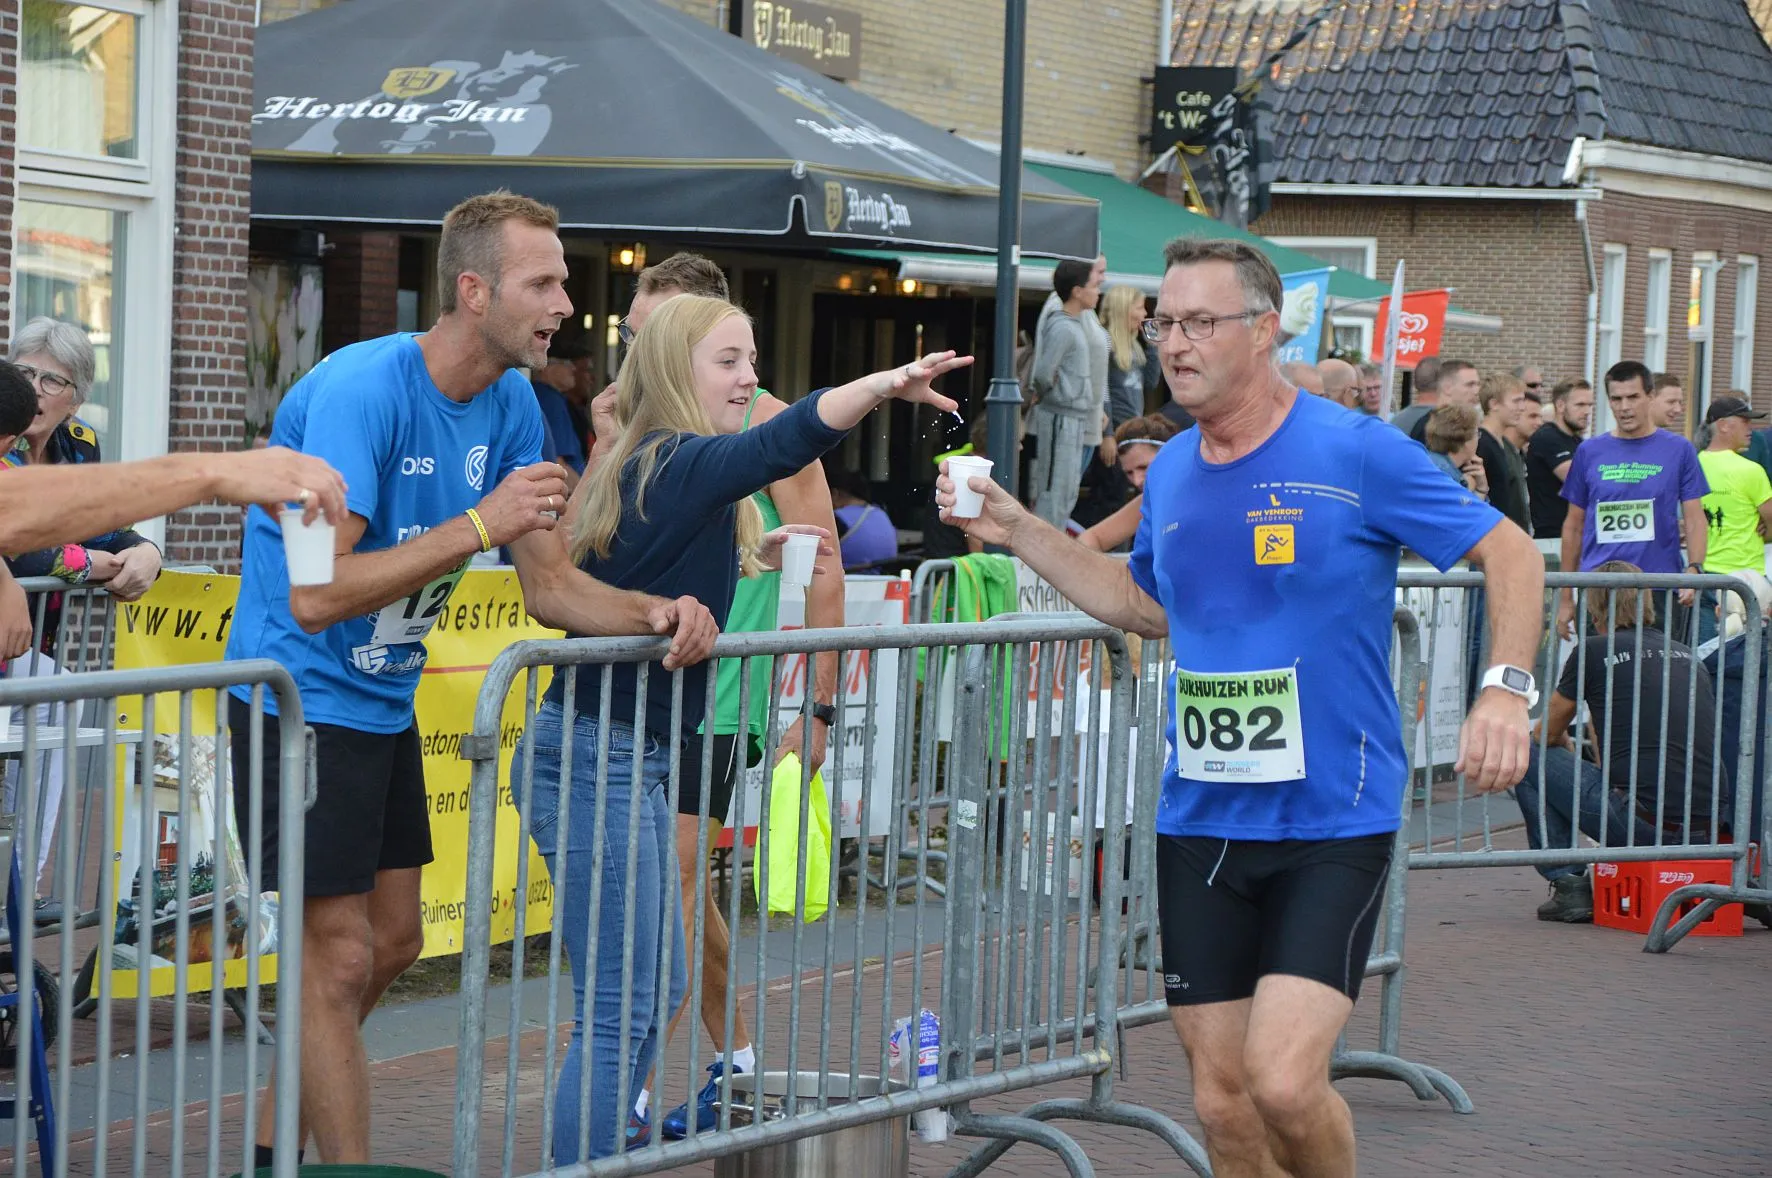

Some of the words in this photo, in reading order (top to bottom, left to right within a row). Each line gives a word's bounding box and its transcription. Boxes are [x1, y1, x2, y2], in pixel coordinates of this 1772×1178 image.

[775, 5, 823, 59] Hertog
[823, 16, 850, 57] Jan
[251, 96, 428, 124] Hertog
[423, 99, 530, 127] Jan
[1176, 91, 1212, 107] Cafe
[845, 186, 888, 232] Hertog
[881, 192, 912, 235] Jan
[1396, 335, 1426, 355] sje?
[1247, 510, 1263, 518] VAN
[1602, 513, 1647, 532] 260
[124, 604, 234, 642] www.t
[1253, 676, 1289, 697] RUN
[1183, 705, 1287, 753] 082
